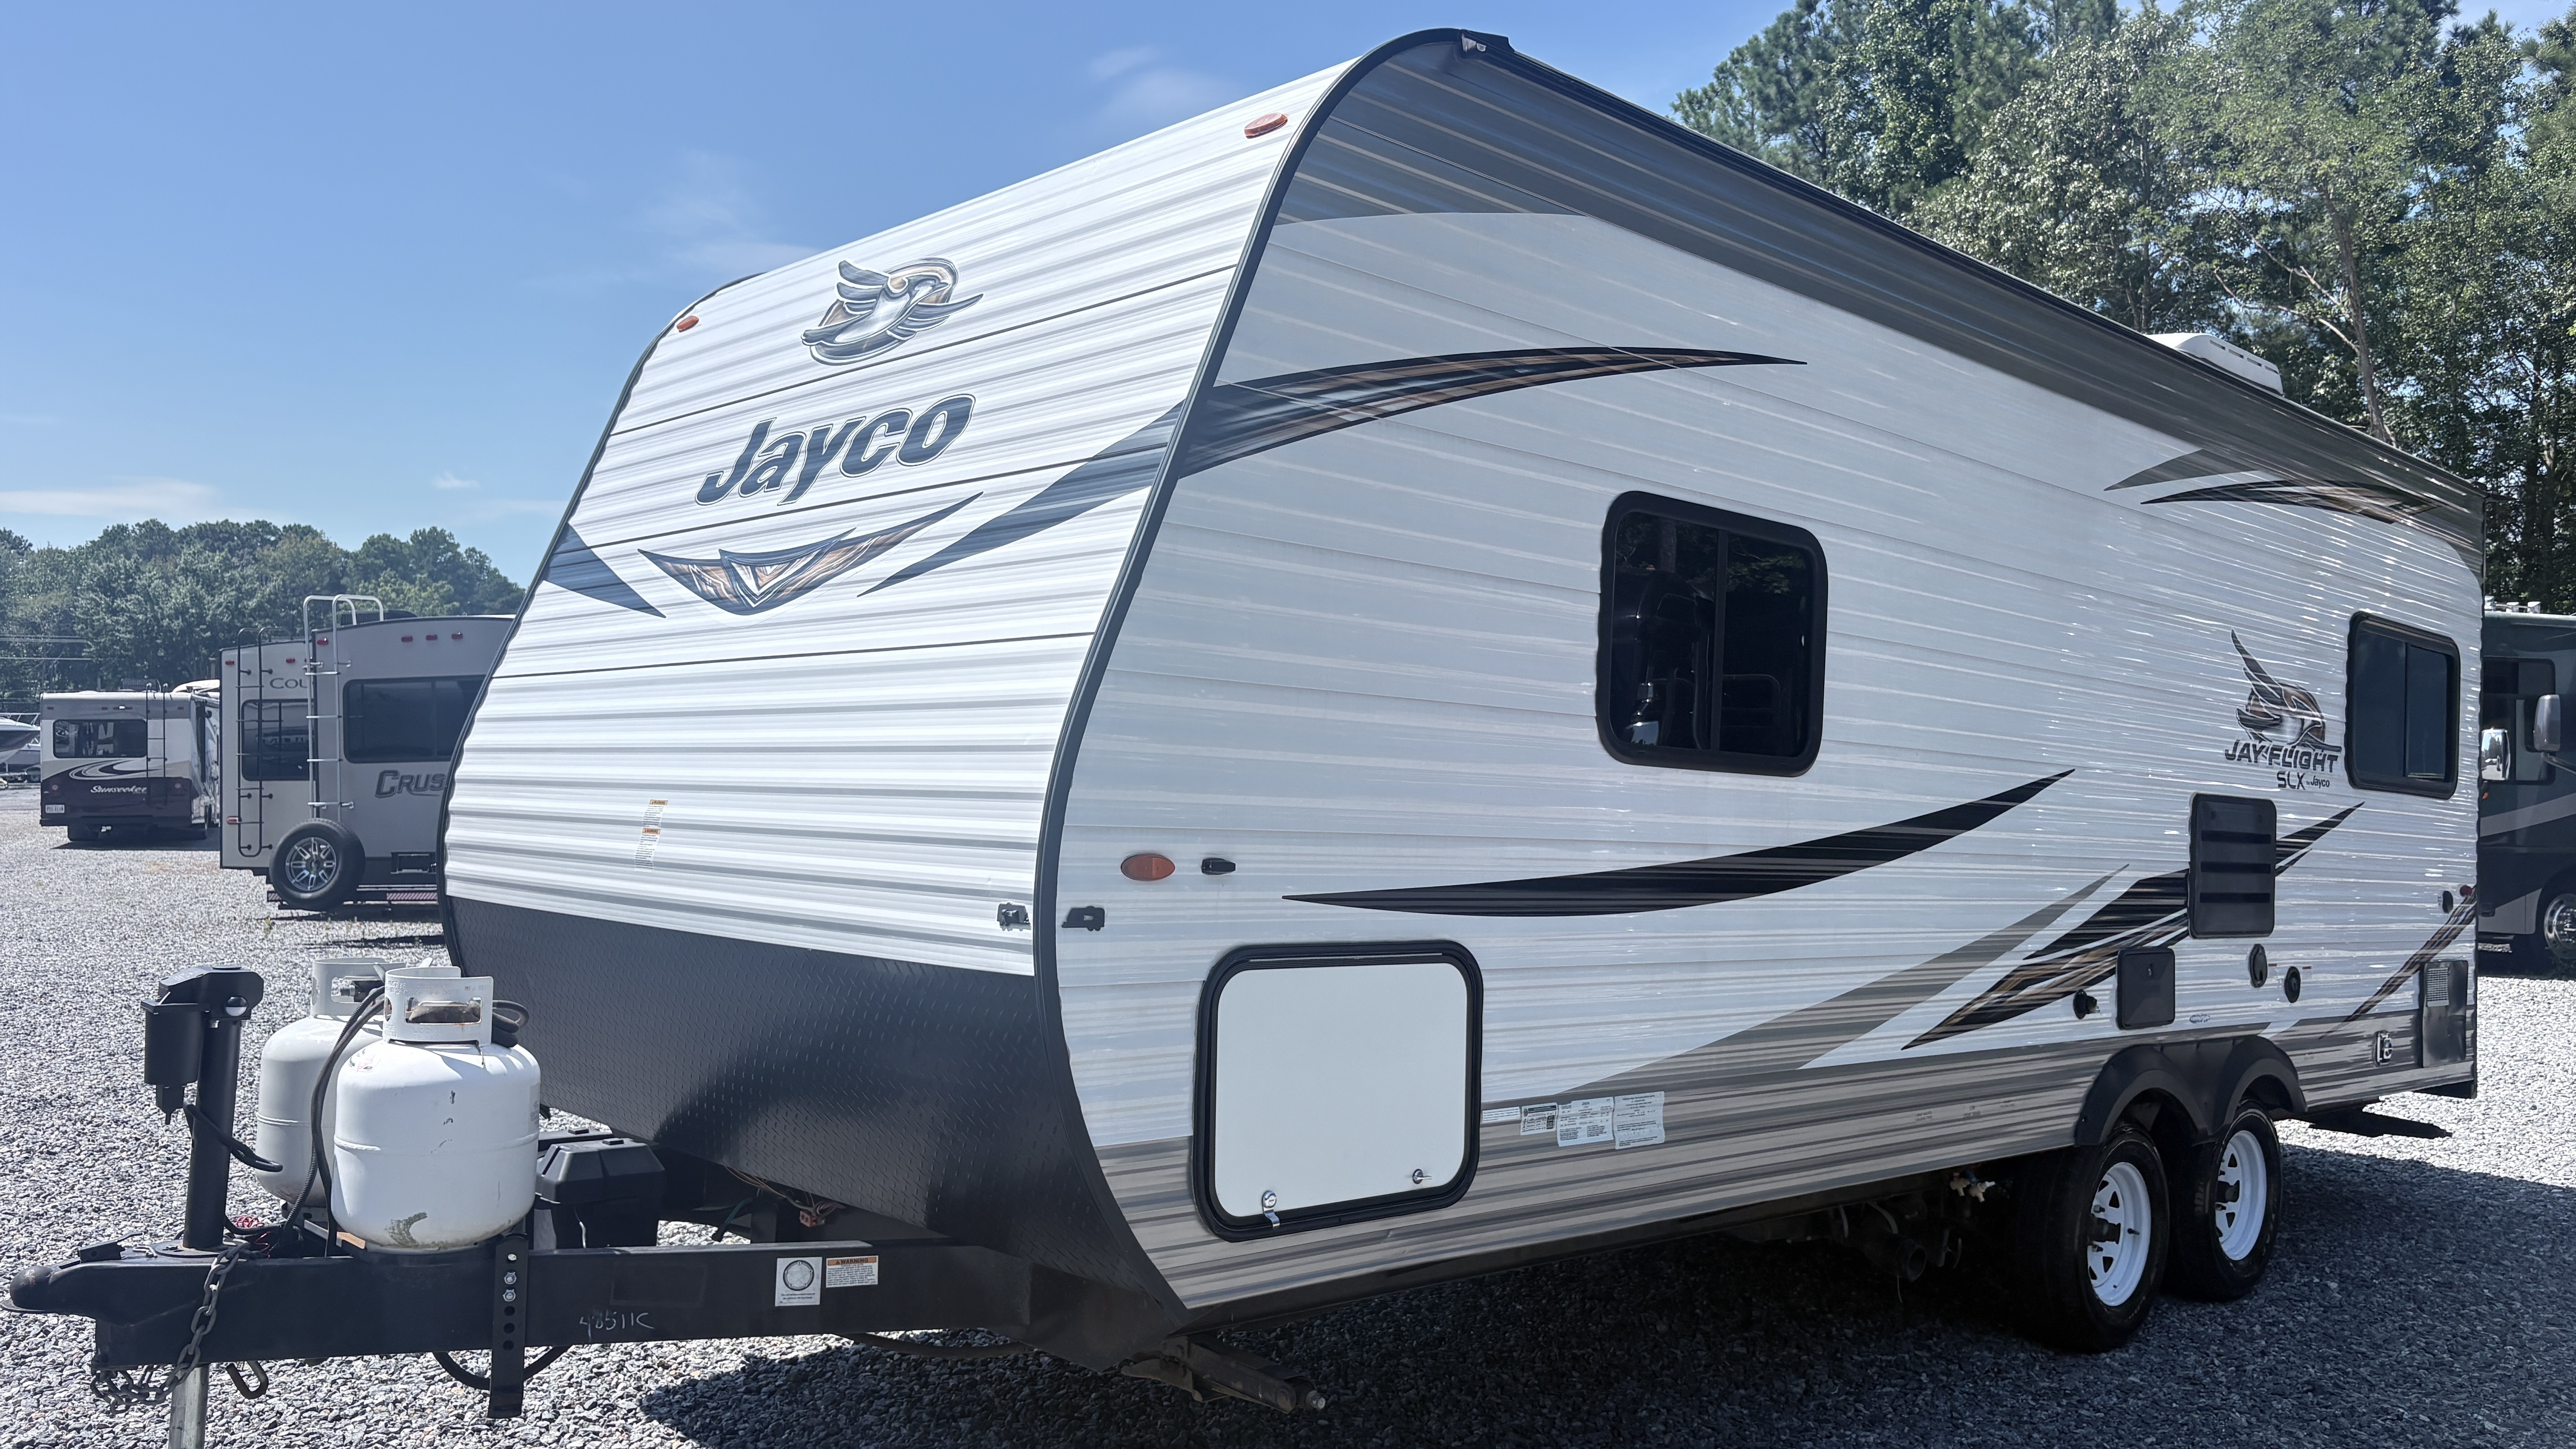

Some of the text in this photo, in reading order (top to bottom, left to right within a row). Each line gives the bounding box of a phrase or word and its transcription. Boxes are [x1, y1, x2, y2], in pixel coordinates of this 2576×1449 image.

[695, 394, 976, 506] Jayco
[2225, 740, 2338, 773] JAY FLIGHT
[91, 785, 147, 793] Sunseeker
[2277, 771, 2306, 790] SLX
[2310, 775, 2330, 789] Jayco
